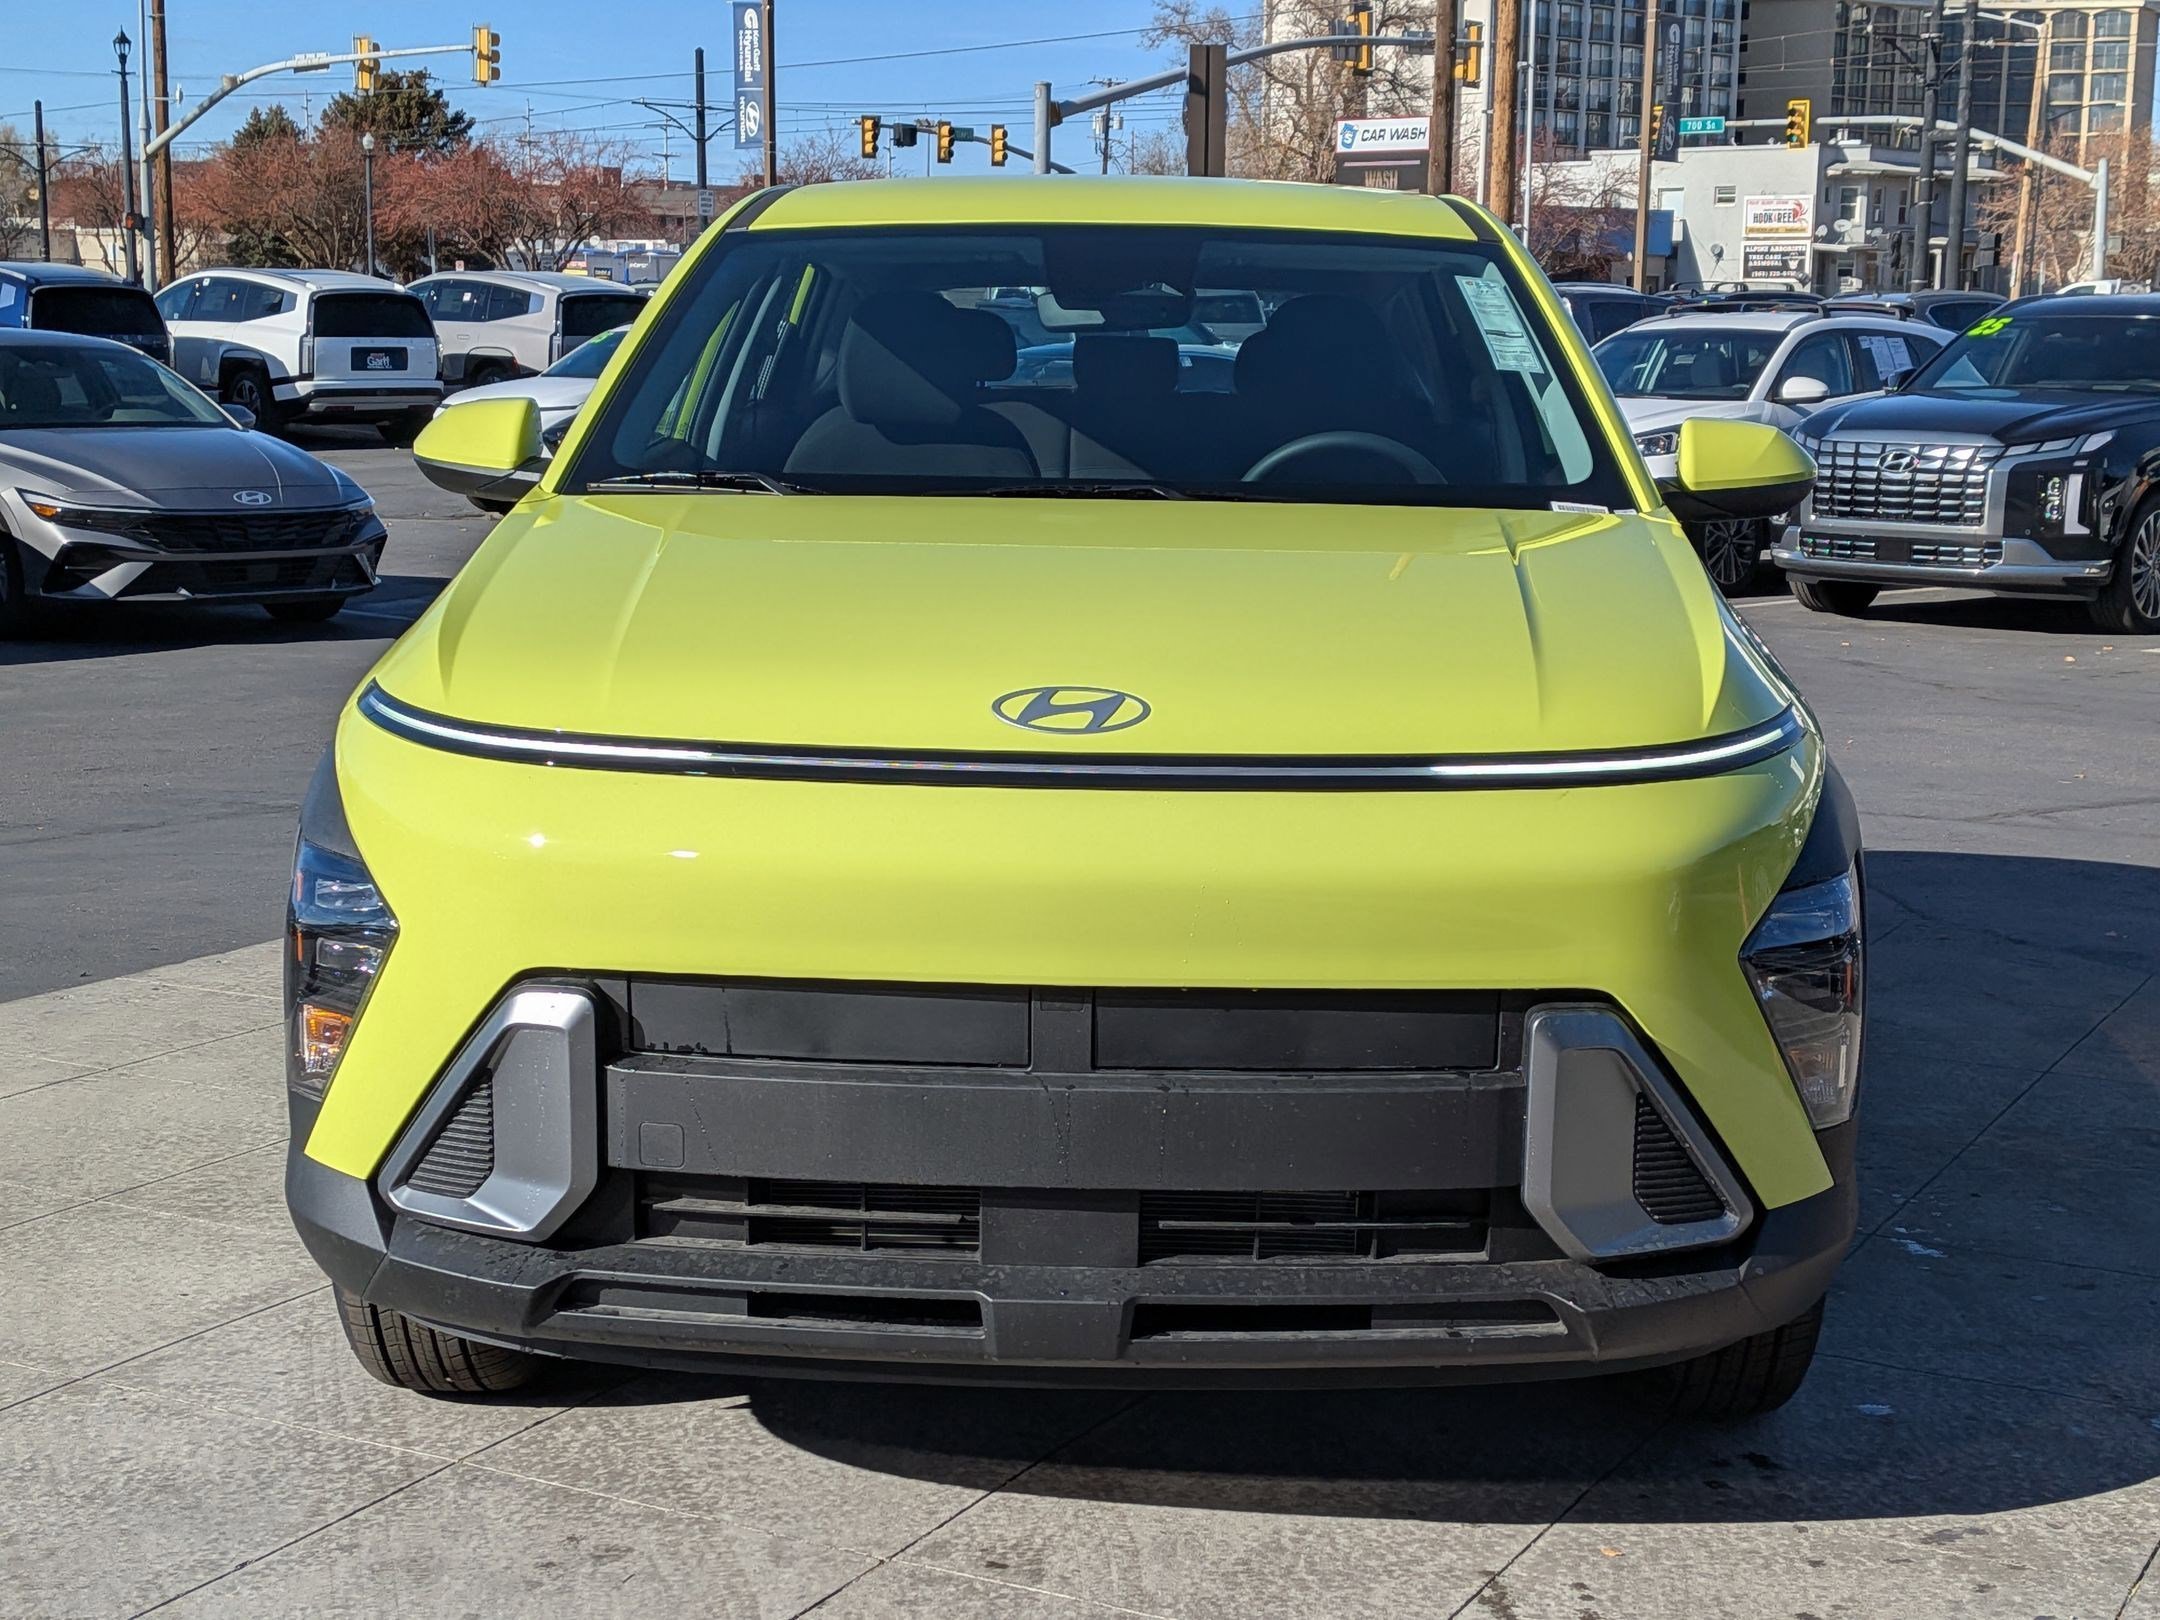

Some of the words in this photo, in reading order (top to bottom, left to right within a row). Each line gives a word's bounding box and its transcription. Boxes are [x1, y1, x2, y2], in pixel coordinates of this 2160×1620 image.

[743, 30, 754, 83] Hyundai
[753, 50, 761, 71] Garff
[1361, 128, 1386, 142] CAR
[1390, 127, 1428, 141] WASH
[1687, 121, 1702, 130] 700
[1365, 169, 1398, 190] WASH
[1967, 317, 2014, 337] 25
